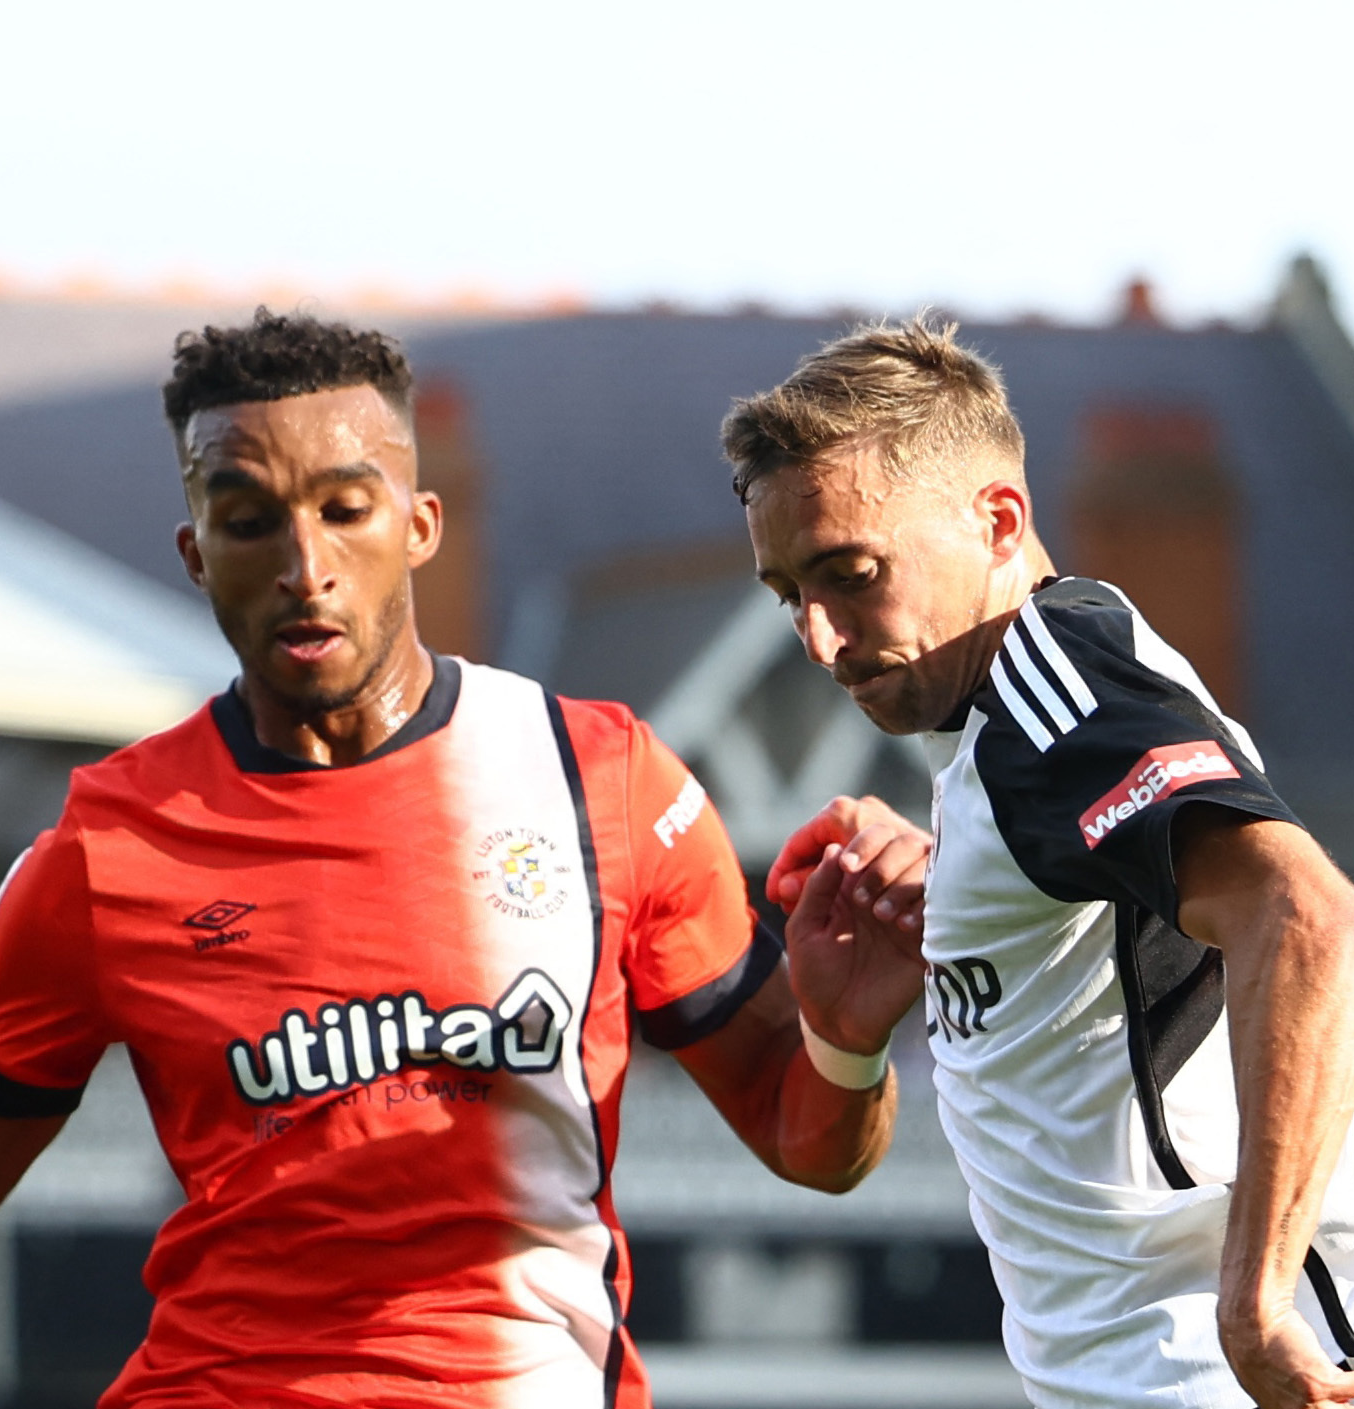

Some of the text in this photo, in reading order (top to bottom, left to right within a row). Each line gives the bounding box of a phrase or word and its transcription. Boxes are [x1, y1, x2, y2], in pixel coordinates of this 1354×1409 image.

[1084, 751, 1233, 840] WebBeds
[475, 826, 558, 858] LUTON TOWN
[485, 888, 569, 920] FOOTBALL CLUB
[229, 993, 498, 1103] utilita
[384, 1075, 495, 1111] power
